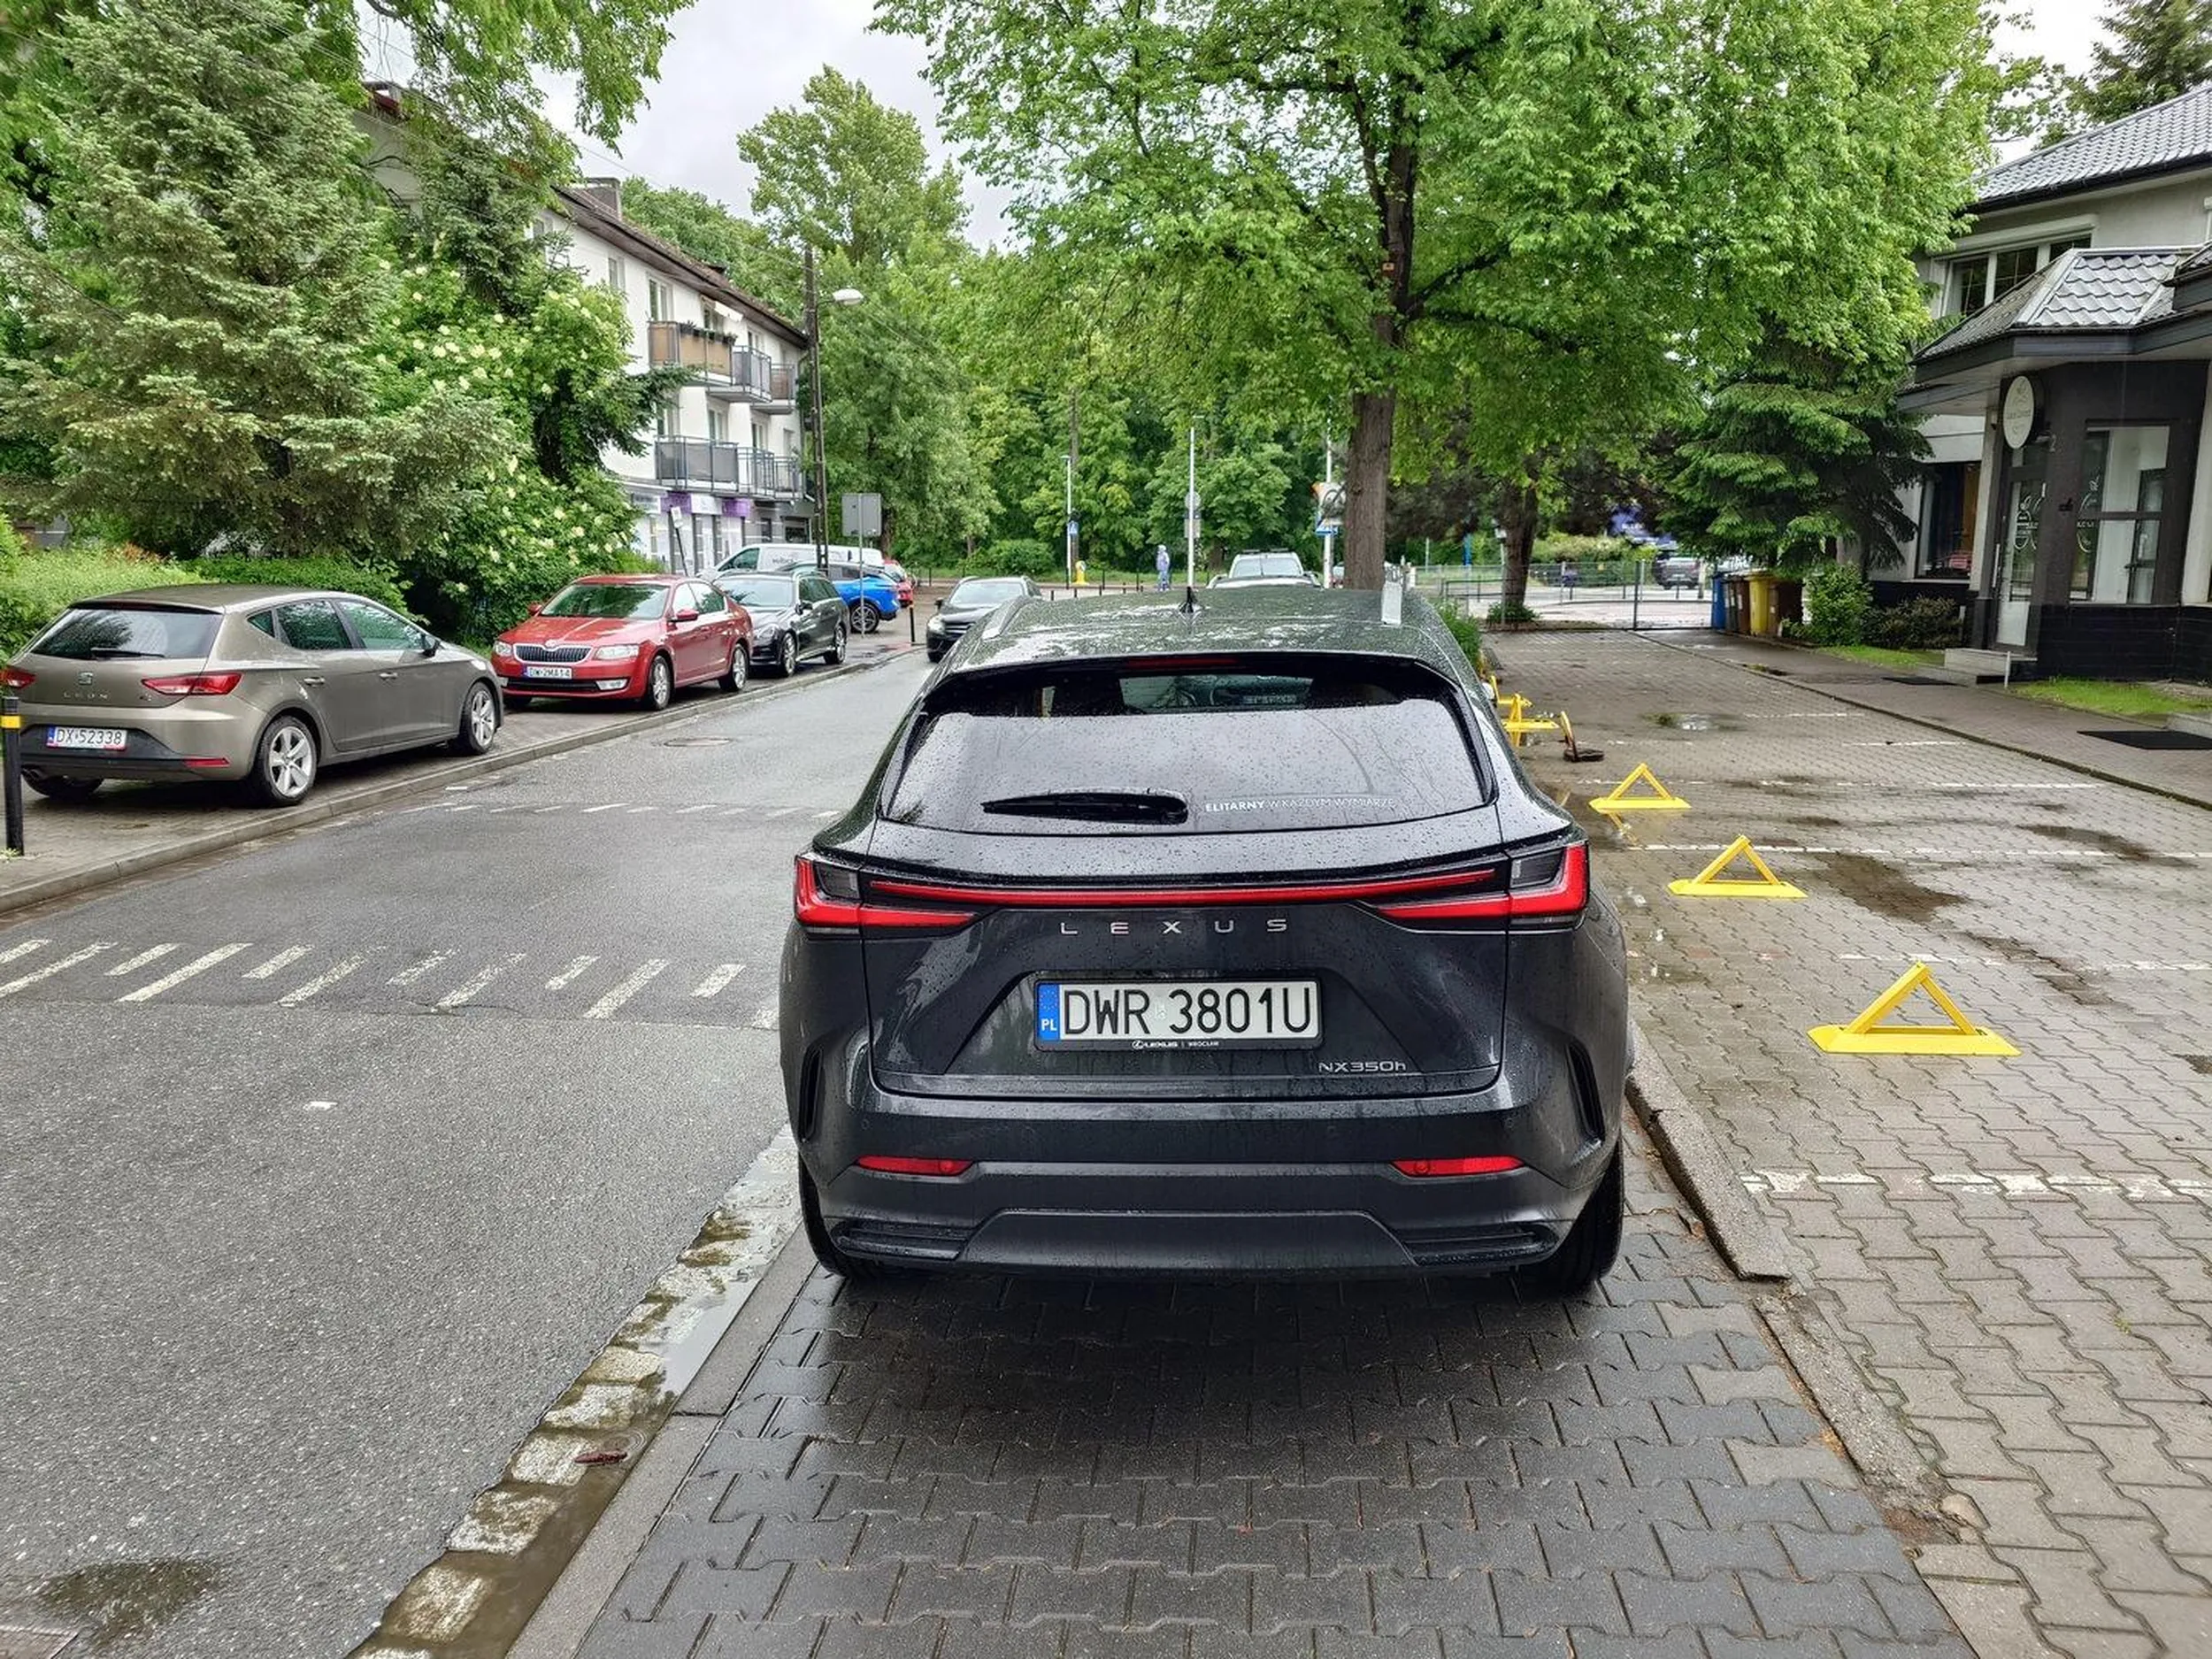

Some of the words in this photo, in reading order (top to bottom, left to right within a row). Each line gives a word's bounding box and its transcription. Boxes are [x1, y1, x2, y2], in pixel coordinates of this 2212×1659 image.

[78, 730, 122, 744] 52338
[1205, 800, 1264, 811] ELITARNY
[1060, 918, 1287, 934] LEXUS
[1064, 988, 1151, 1035] DWR
[1168, 987, 1311, 1034] 3801U
[1041, 1019, 1058, 1032] PL
[1318, 1061, 1407, 1073] NX350h
